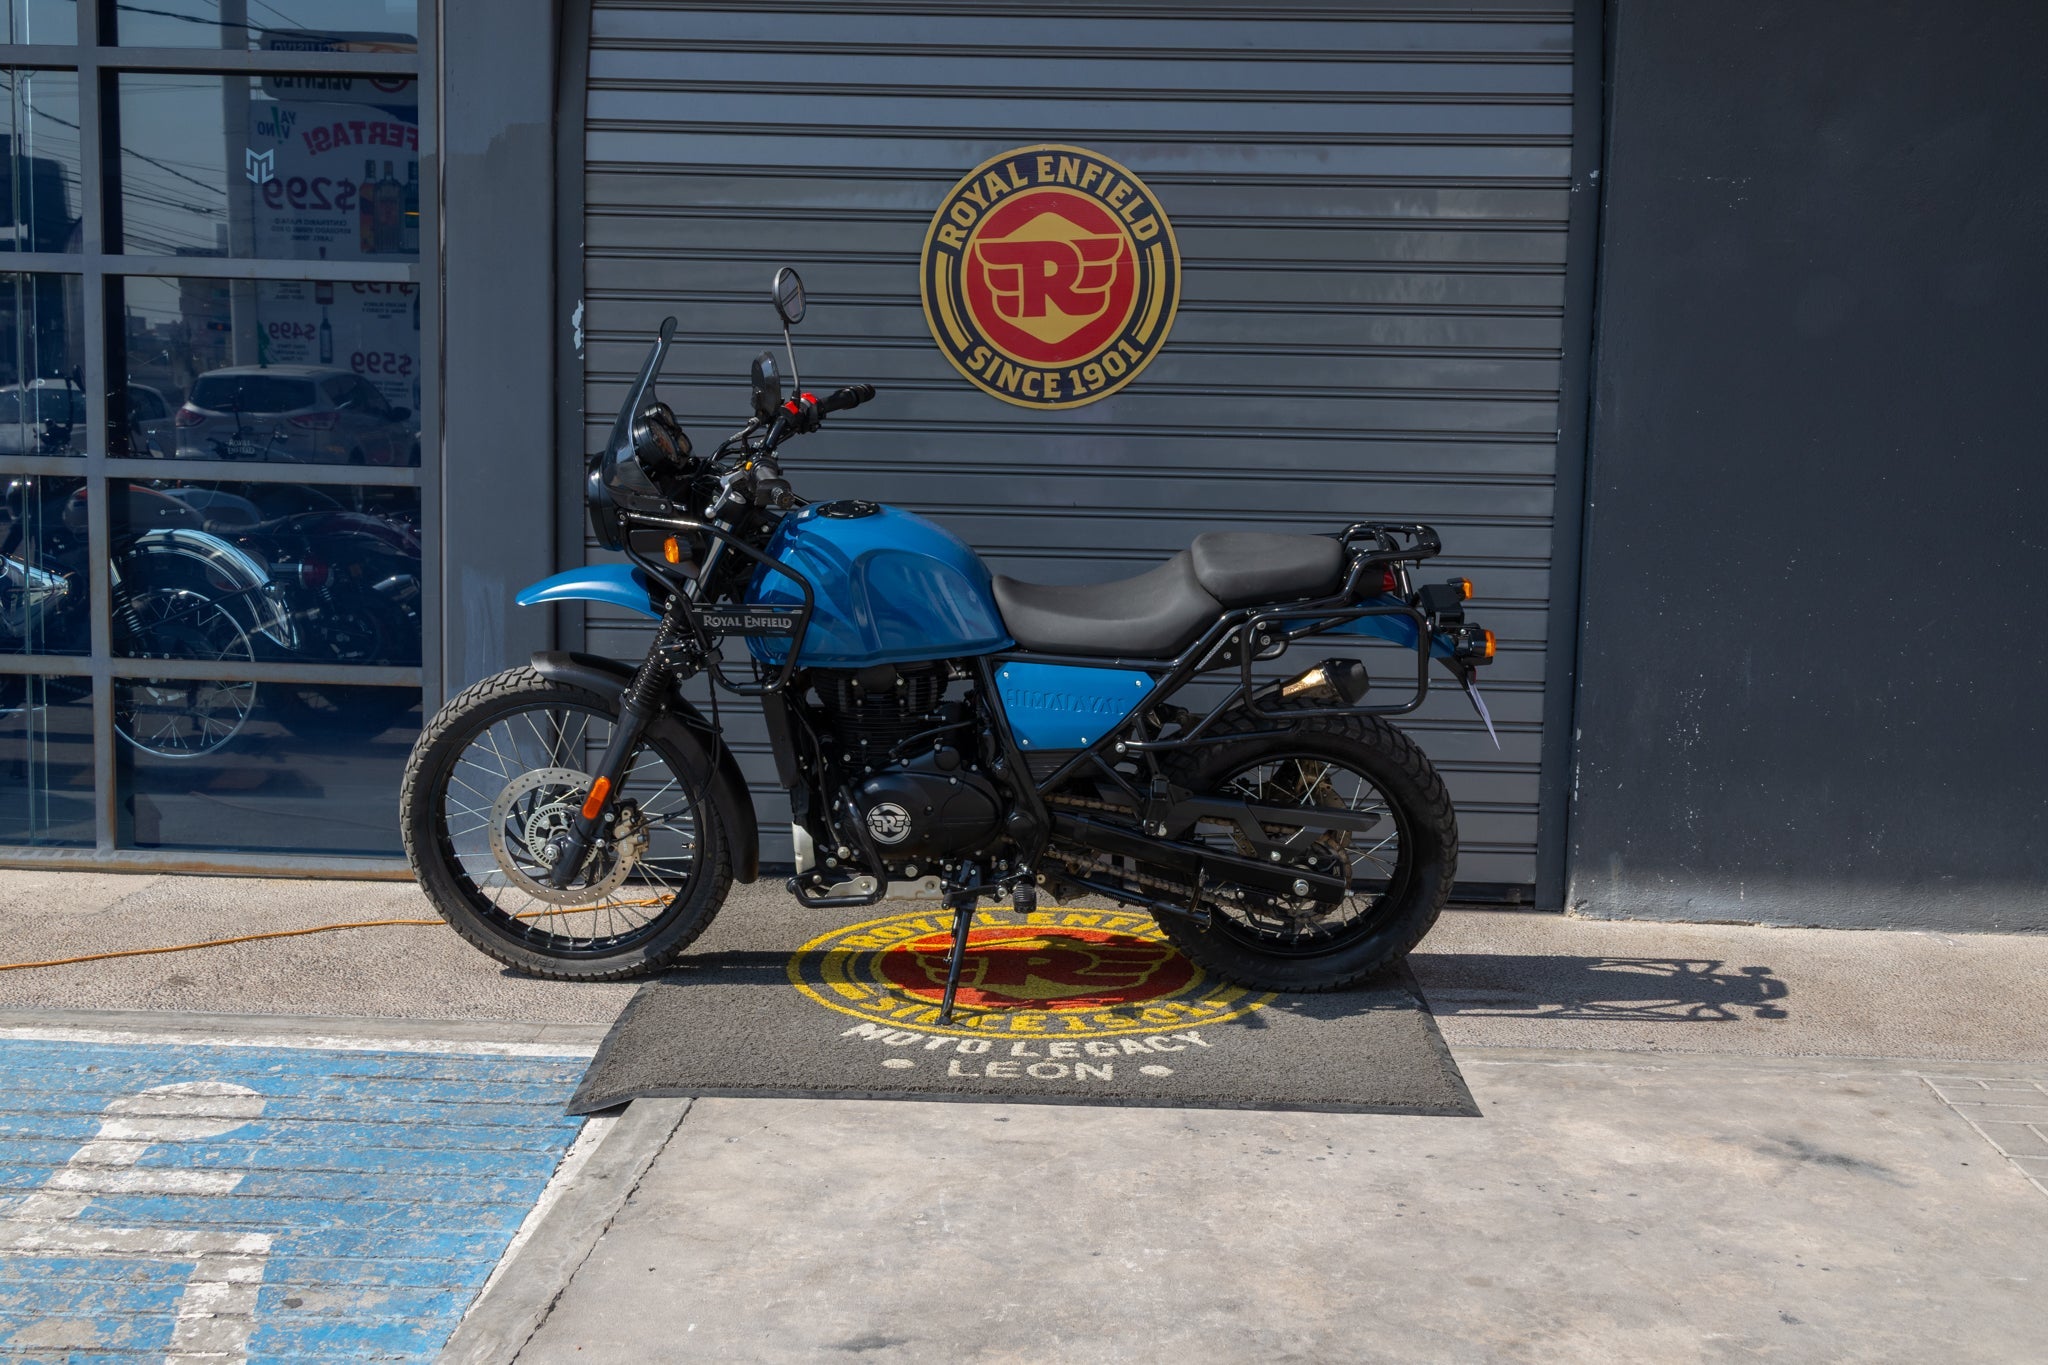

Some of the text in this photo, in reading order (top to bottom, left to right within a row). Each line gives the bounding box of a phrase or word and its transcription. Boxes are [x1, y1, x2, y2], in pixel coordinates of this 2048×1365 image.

[937, 156, 1162, 250] ROYAL ENFIELD
[966, 338, 1144, 398] SINCE 1901
[703, 614, 792, 629] ROYAL ENFIELD
[1007, 689, 1126, 716] HIMALAYAN
[859, 995, 1215, 1031] SINCE 1901
[839, 1022, 1214, 1058] MOTO LEGACY
[948, 1057, 1114, 1081] LEÓN
